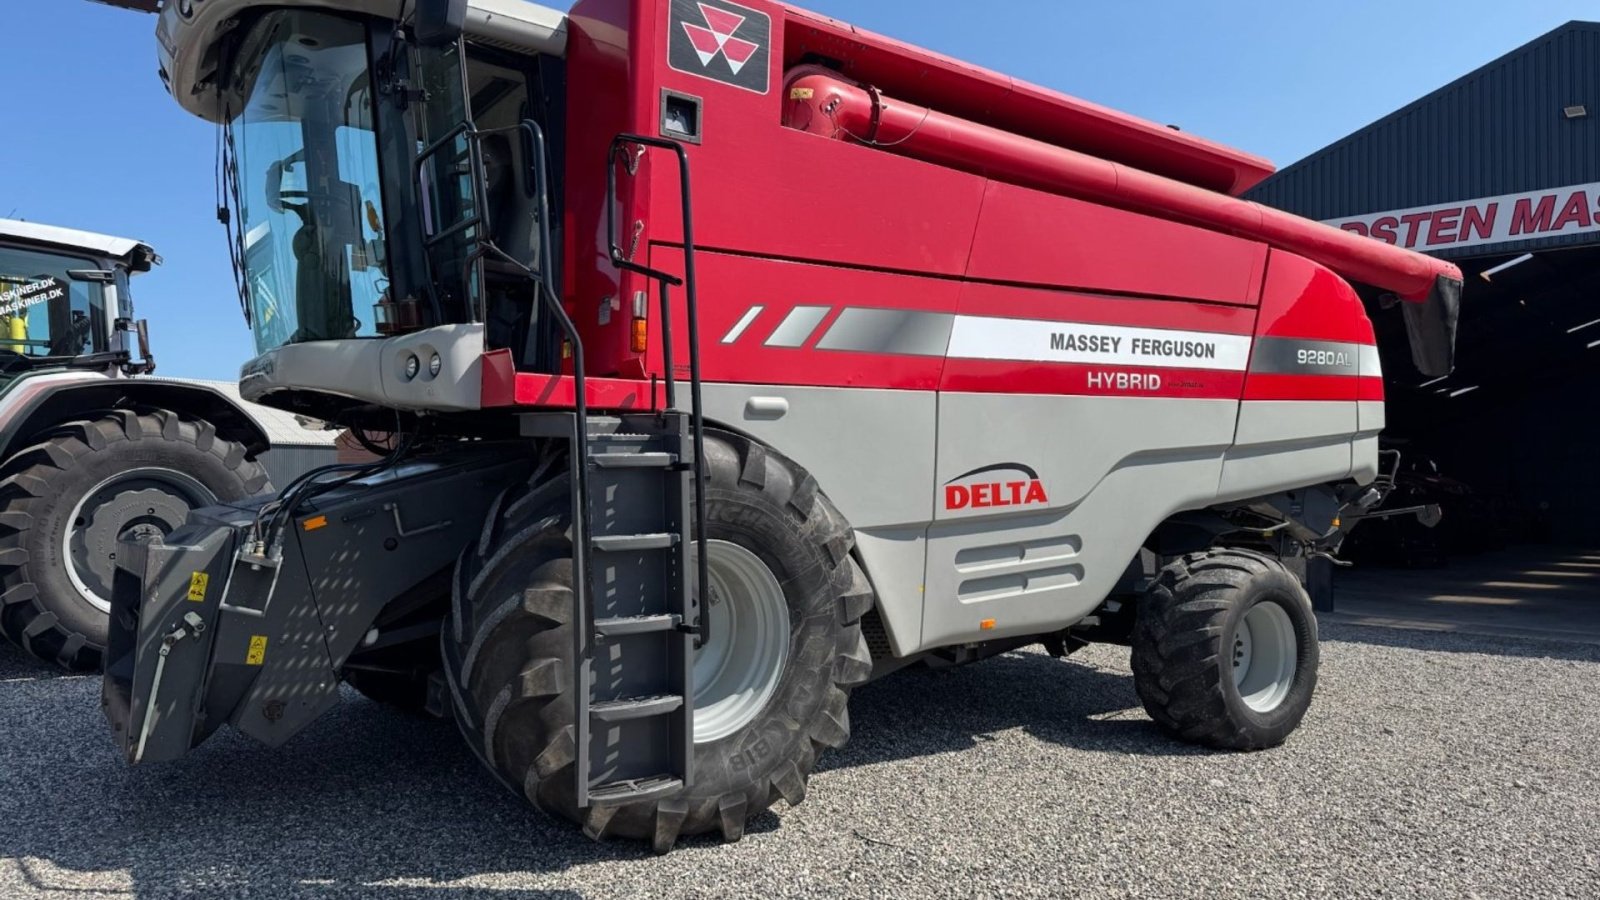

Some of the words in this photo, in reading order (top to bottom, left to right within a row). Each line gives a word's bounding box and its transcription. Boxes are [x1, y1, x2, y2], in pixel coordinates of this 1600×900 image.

[1049, 332, 1122, 354] MASSEY
[1131, 338, 1216, 359] FERGUSON
[1296, 348, 1353, 367] 9280AL
[1087, 371, 1162, 391] HYBRID
[945, 479, 1049, 510] DELTA
